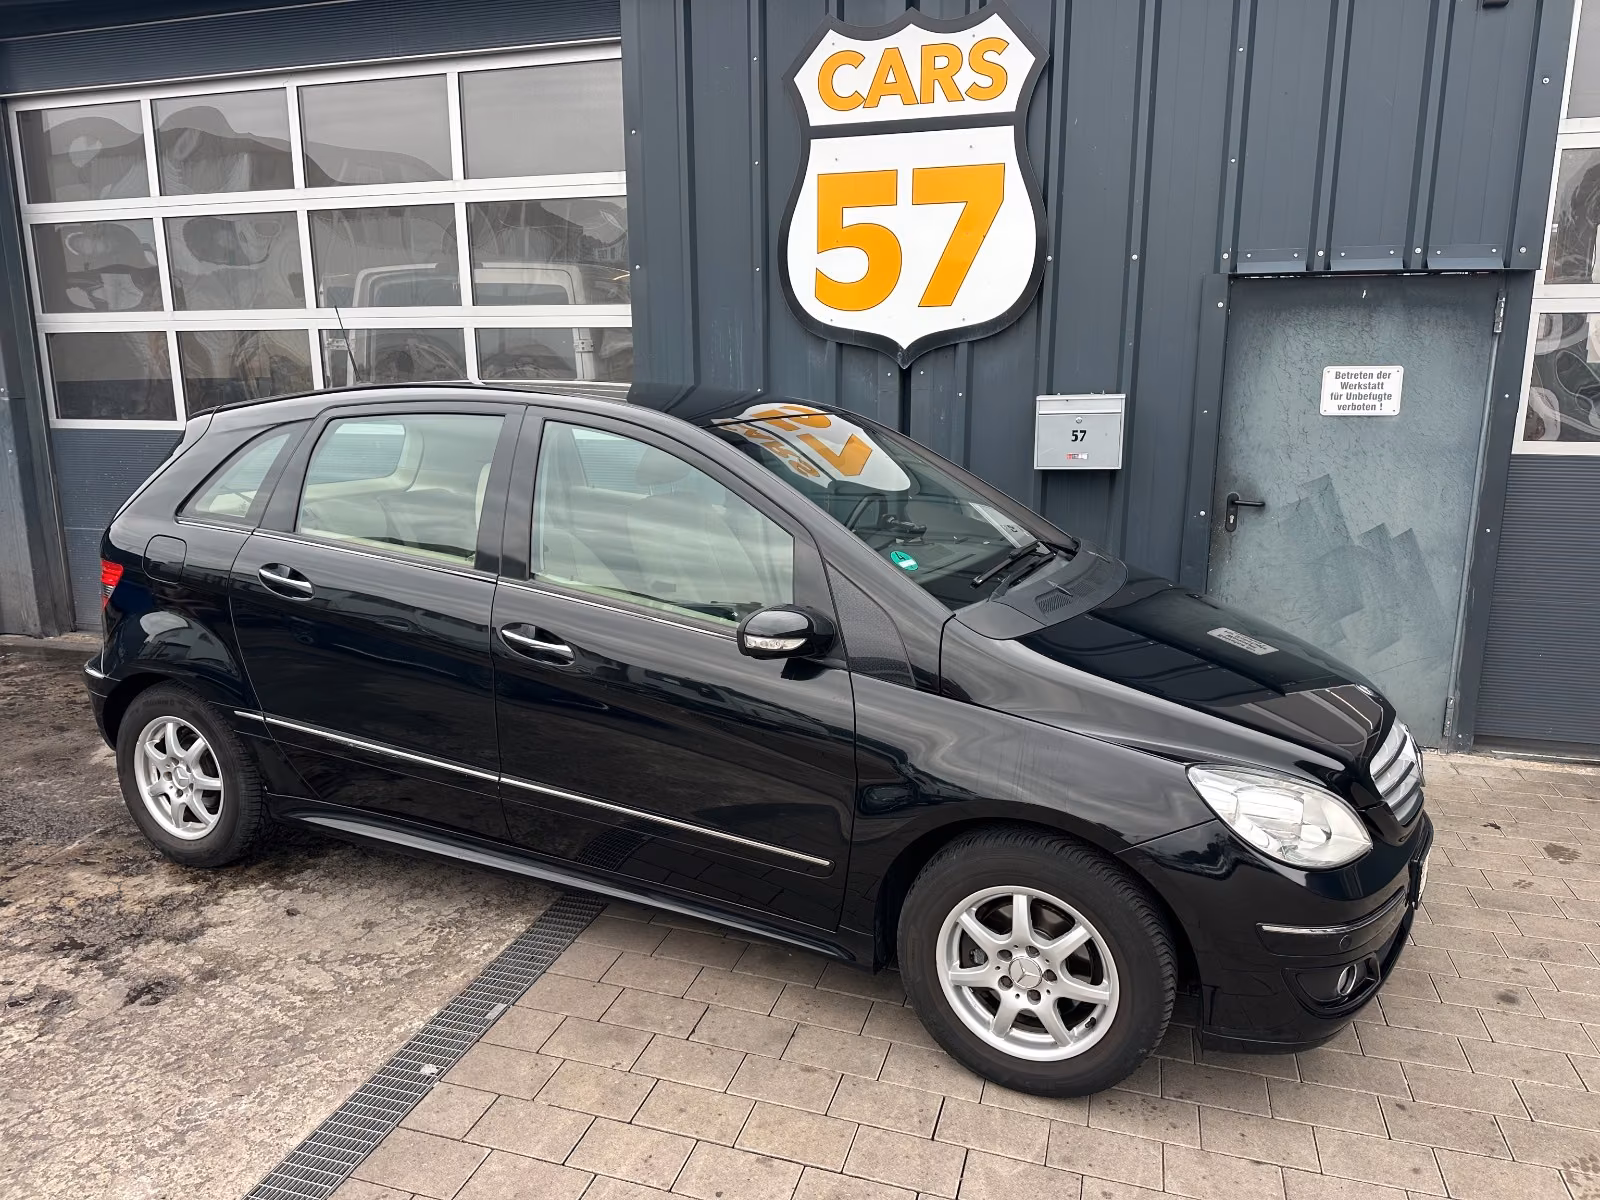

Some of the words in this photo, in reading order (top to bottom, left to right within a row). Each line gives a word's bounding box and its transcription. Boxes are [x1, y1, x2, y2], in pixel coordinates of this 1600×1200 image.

[817, 37, 1009, 112] CARS
[815, 162, 1006, 312] 57
[1335, 371, 1373, 380] Betreten
[1376, 371, 1392, 380] der
[1340, 381, 1384, 390] Werkstatt
[1330, 392, 1343, 400] für
[1345, 392, 1393, 402] Unbefugte
[1337, 403, 1376, 411] verboten
[1379, 403, 1383, 411] !
[1071, 429, 1087, 442] 57
[894, 551, 906, 561] 4
